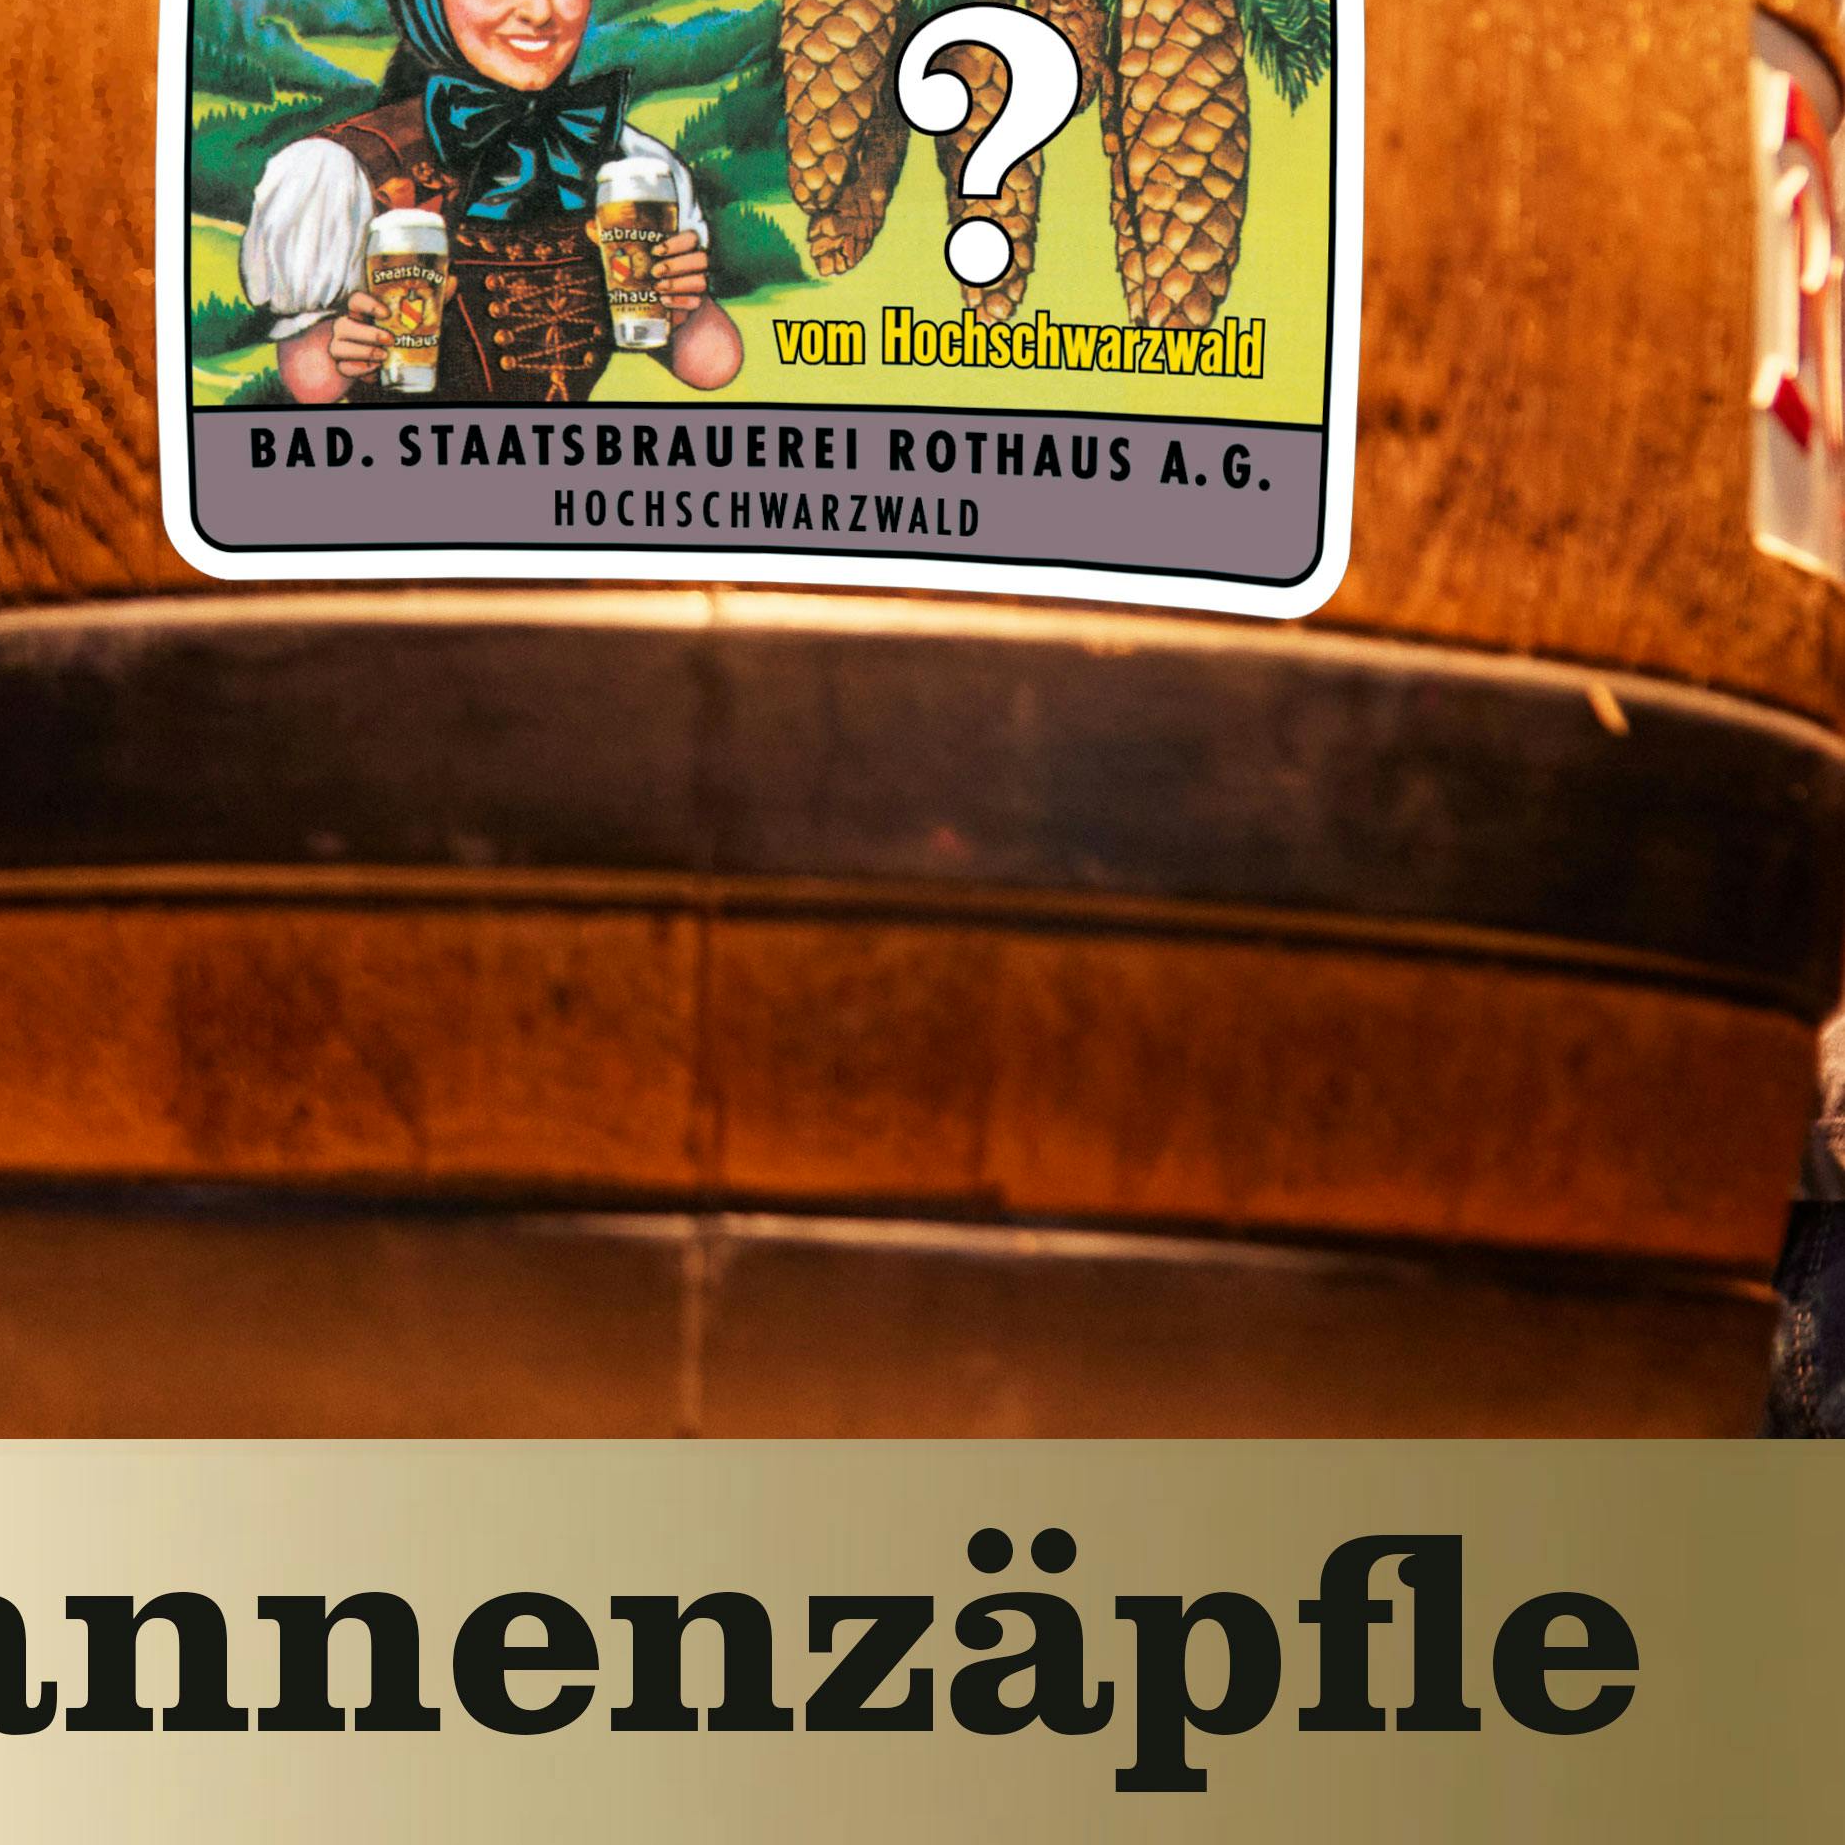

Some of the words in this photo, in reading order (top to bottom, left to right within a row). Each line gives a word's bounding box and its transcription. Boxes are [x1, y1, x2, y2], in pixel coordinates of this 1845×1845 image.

[895, 2, 1084, 288] ?
[773, 319, 866, 365] vom
[882, 306, 1266, 379] Hochschwarzwald
[251, 427, 374, 468] BAD.
[399, 424, 858, 470] STAATSBRAUEREI
[889, 429, 1132, 482] ROTHAUS
[554, 490, 980, 538] HOCHSCHWARZWALD
